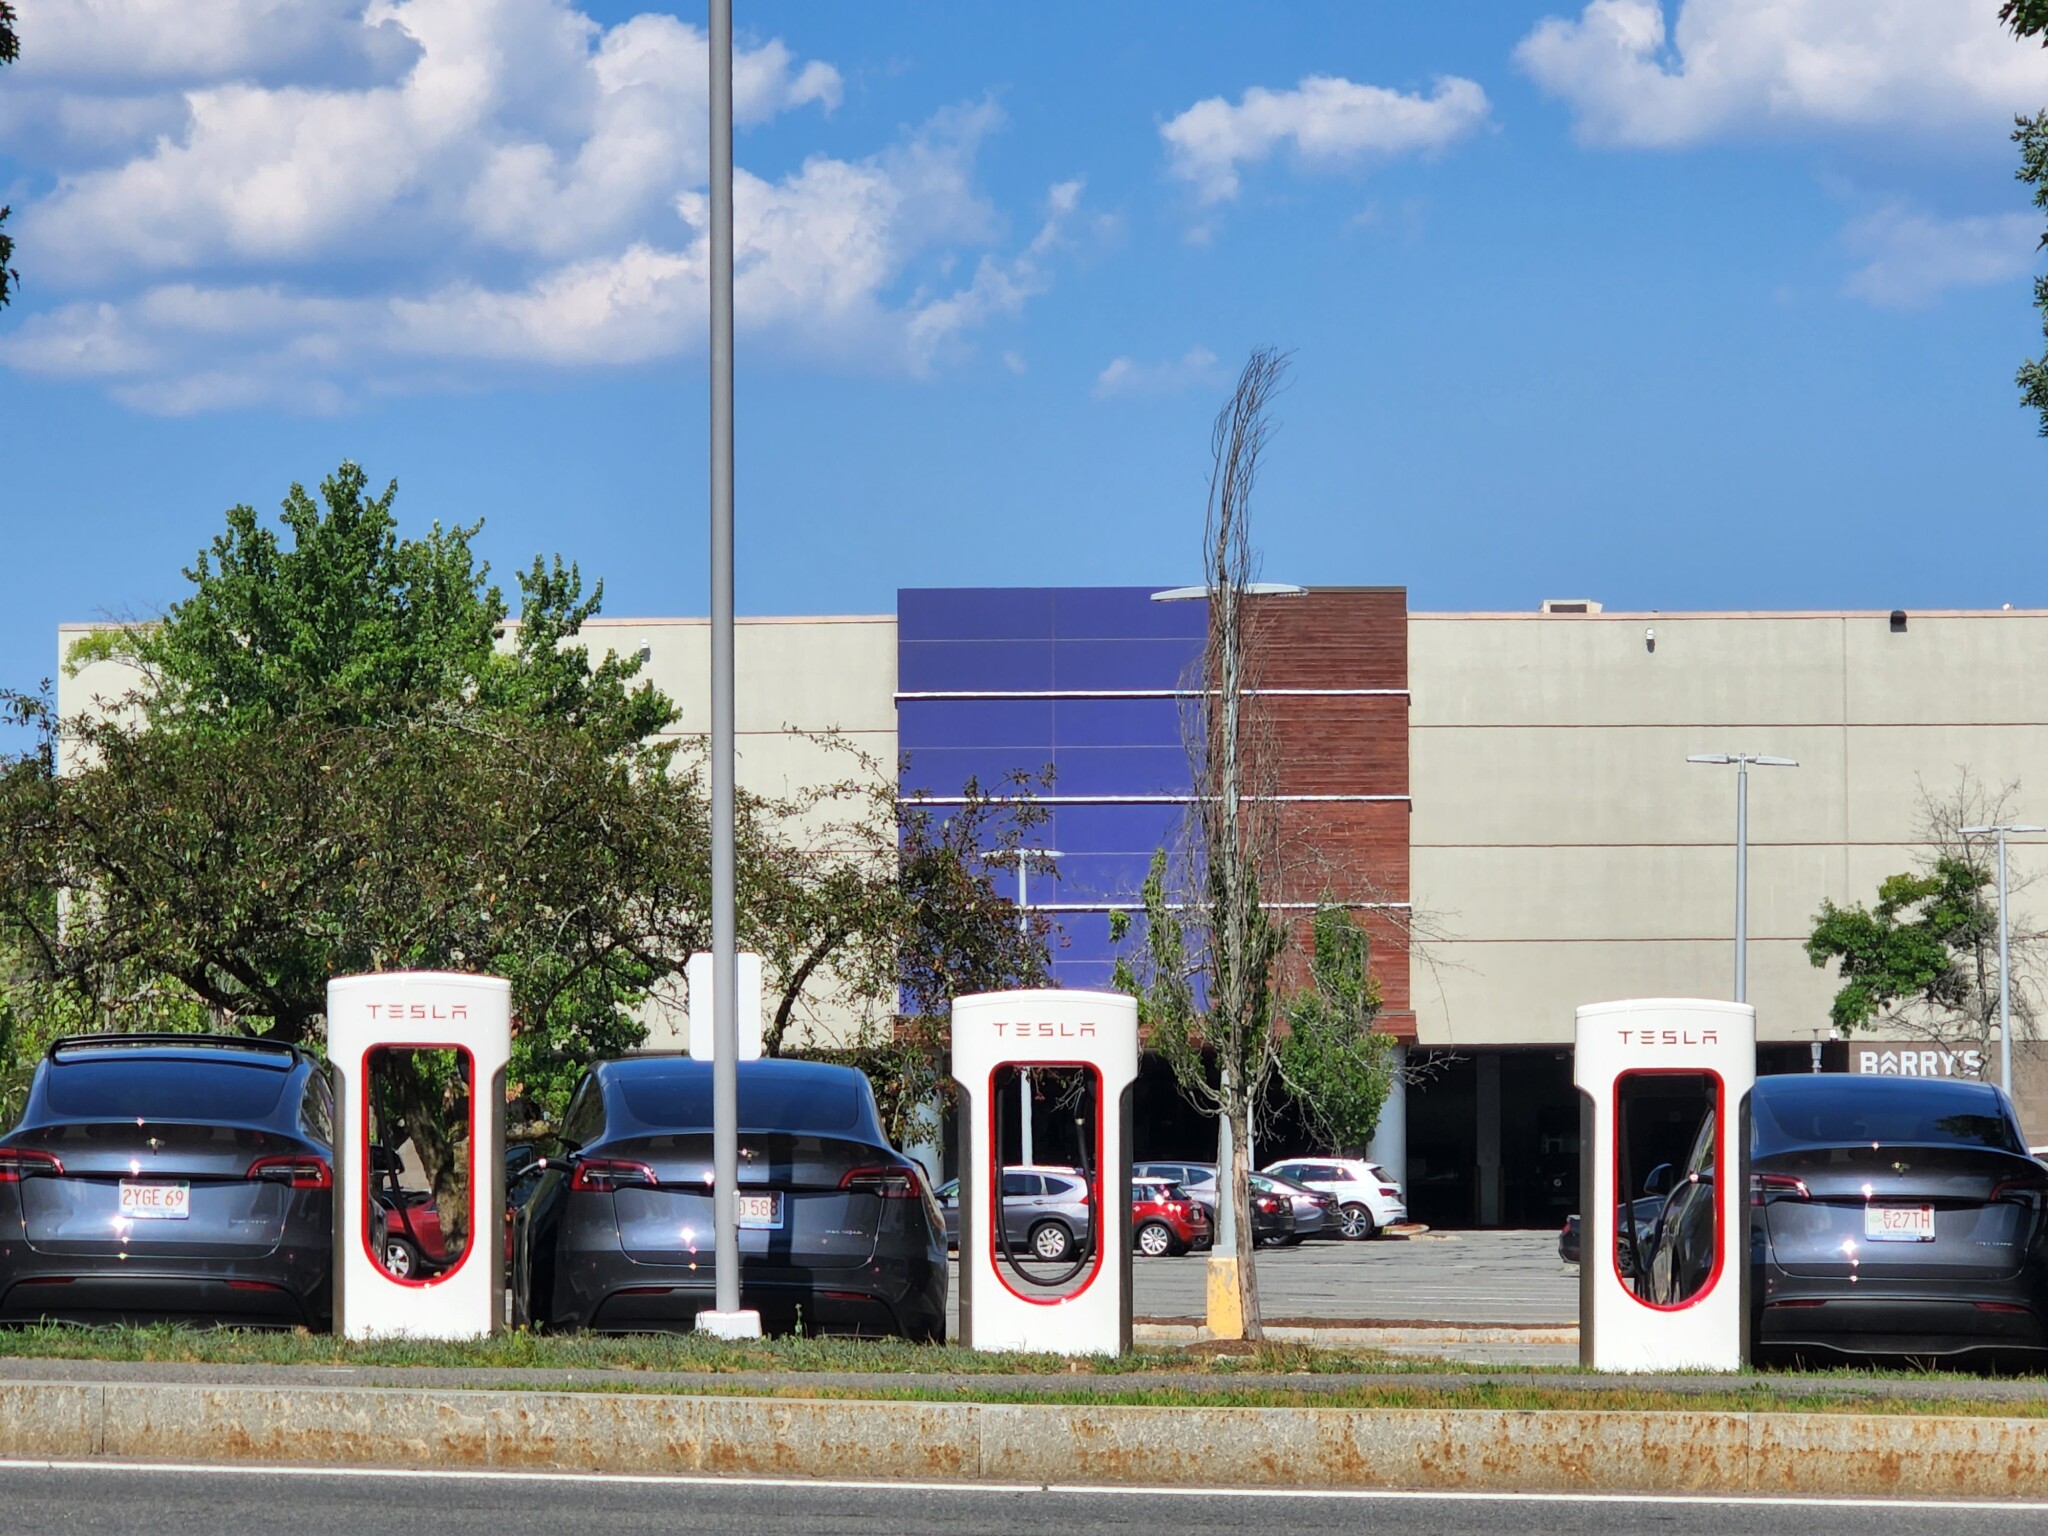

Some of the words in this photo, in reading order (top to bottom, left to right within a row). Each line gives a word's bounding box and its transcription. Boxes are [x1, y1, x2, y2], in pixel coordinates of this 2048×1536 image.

[366, 1004, 467, 1019] TESLA
[992, 1022, 1095, 1037] TESLA
[1617, 1030, 1717, 1045] TESLA
[1859, 1050, 1981, 1076] BARRY'S
[122, 1188, 161, 1206] 2YGE
[165, 1189, 184, 1207] 69
[750, 1199, 778, 1216] 588
